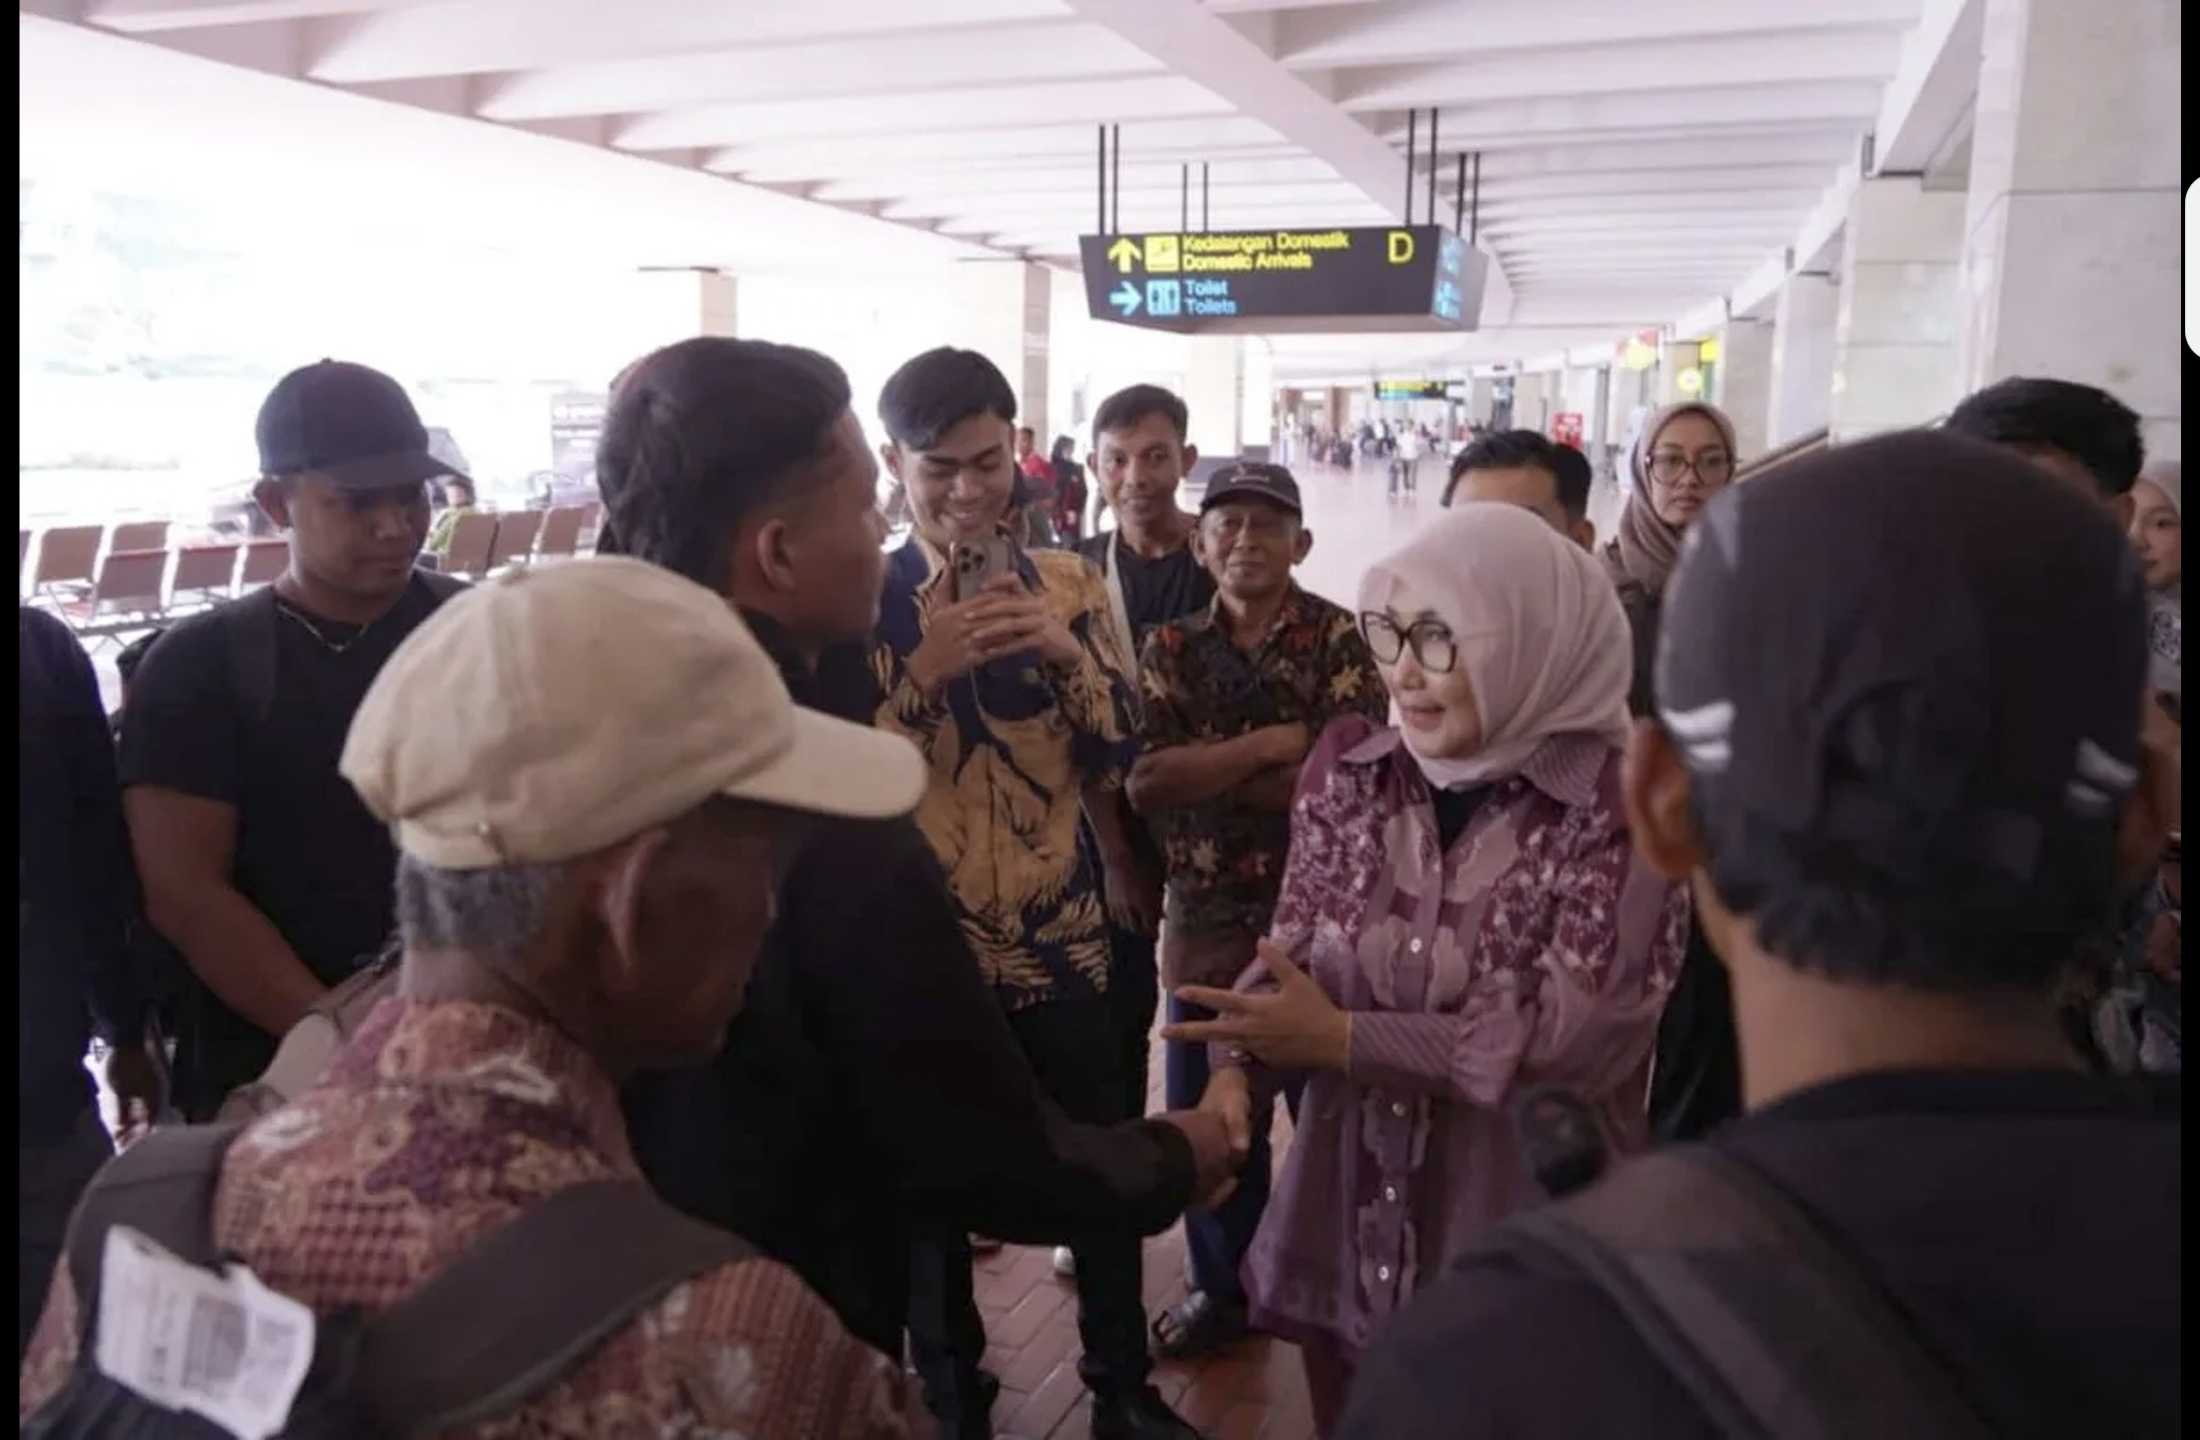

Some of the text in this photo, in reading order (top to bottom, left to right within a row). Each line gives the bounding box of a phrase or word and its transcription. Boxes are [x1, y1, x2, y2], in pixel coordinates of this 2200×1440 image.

[1276, 231, 1349, 249] Domestik
[1388, 231, 1414, 263] D
[1182, 252, 1313, 270] Domestic Arrivals
[1184, 279, 1228, 296] Toilet
[1184, 298, 1237, 315] Toilets
